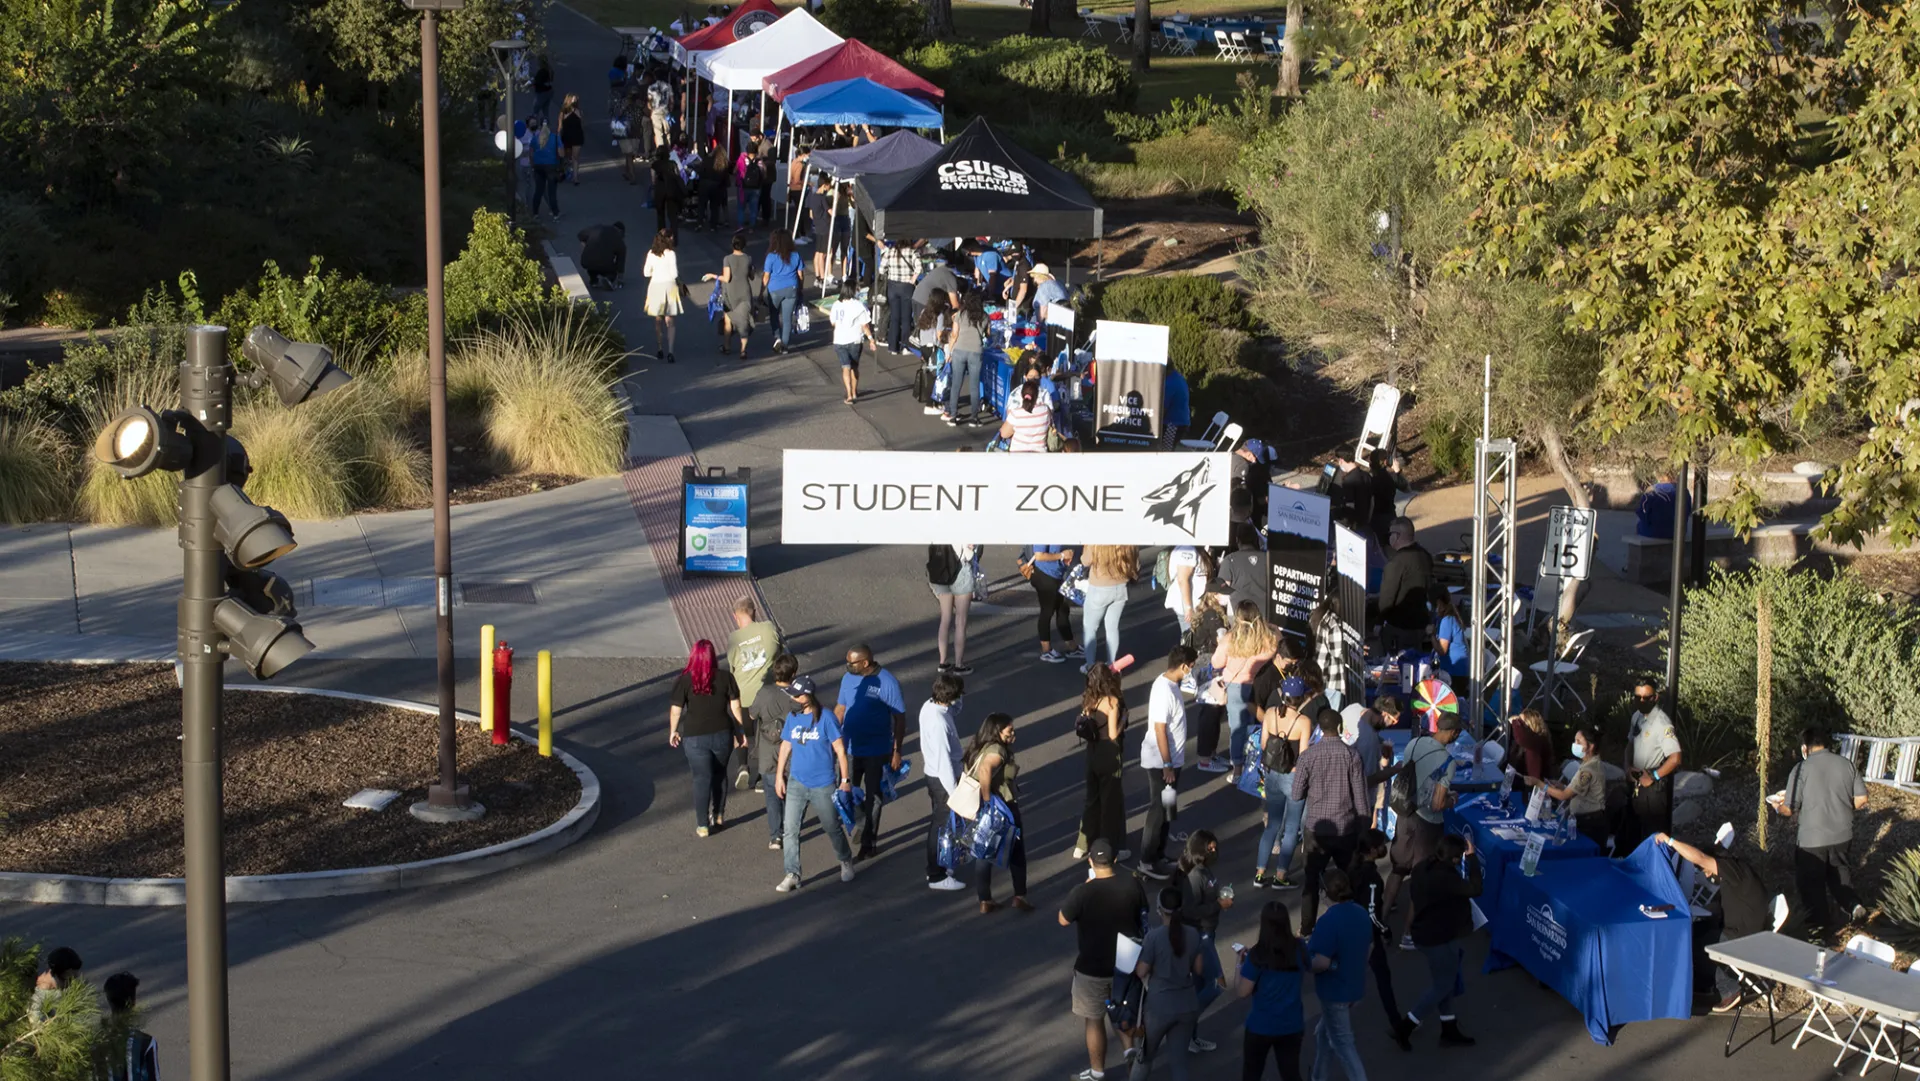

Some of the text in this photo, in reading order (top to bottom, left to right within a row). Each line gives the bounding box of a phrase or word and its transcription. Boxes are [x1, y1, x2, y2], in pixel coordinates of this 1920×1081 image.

[938, 160, 1027, 185] CSUSB
[940, 175, 1028, 189] RECREATION
[941, 182, 1029, 195] & WELLNESS
[1119, 395, 1138, 406] VICE
[1102, 404, 1154, 417] PRESIDENT'S
[1113, 416, 1142, 427] OFFICE
[802, 483, 1125, 511] STUDENT ZONE
[1554, 513, 1588, 526] SPEED
[1554, 526, 1584, 538] LIMIT
[1553, 543, 1578, 569] 15
[1273, 564, 1321, 587] DEPARTMENT
[1271, 589, 1278, 600] &
[1274, 578, 1319, 599] OF HOUSING
[1275, 604, 1310, 622] EDUCATIO
